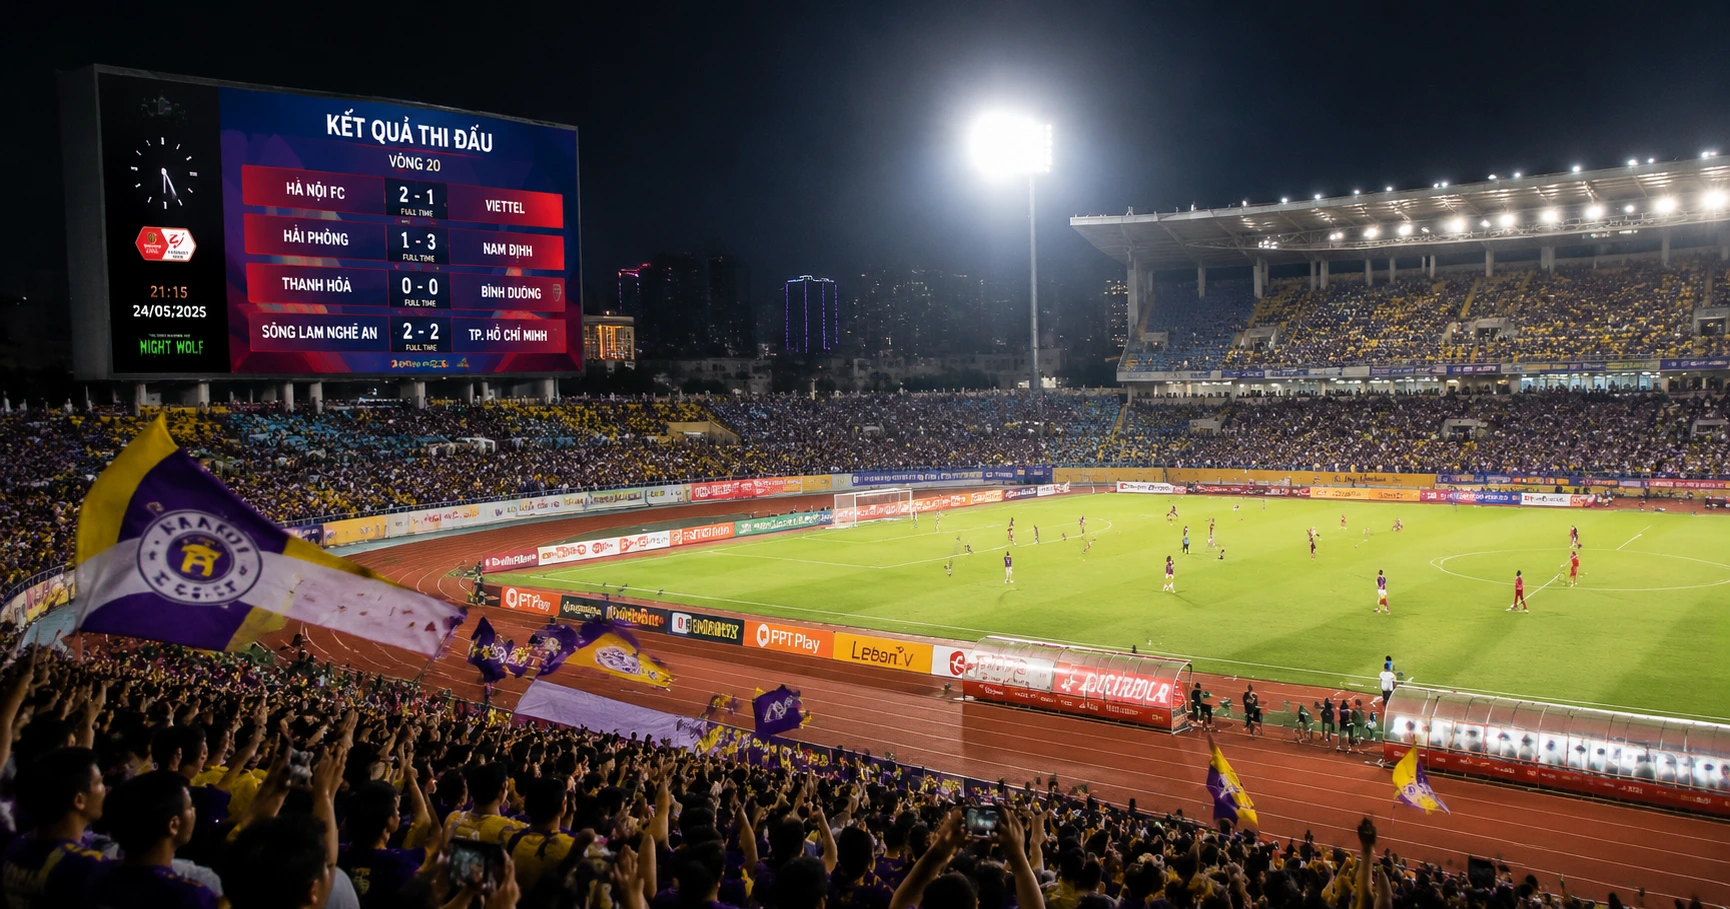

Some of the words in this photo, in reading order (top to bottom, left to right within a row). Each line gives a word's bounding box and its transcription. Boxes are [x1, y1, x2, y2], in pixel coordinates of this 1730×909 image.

[326, 108, 366, 138] KẾT
[371, 116, 414, 145] QUẢ
[418, 124, 449, 148] THI
[453, 124, 493, 153] ĐẤU
[426, 158, 441, 172] 20
[330, 186, 346, 200] FC
[399, 185, 409, 203] 2
[426, 189, 434, 205] 1
[400, 208, 416, 217] FULL
[485, 199, 526, 214] VIETTEL
[283, 224, 305, 244] HẢI
[307, 228, 349, 246] PHÒNG
[401, 231, 410, 249] 1
[426, 233, 437, 250] 3
[483, 242, 506, 256] NAM
[402, 253, 418, 262] FULL
[281, 276, 324, 292] THANH
[401, 276, 412, 295] 0
[428, 278, 439, 296] 0
[150, 285, 188, 299] 21:15
[404, 298, 420, 307] FULL
[299, 325, 324, 339] LAM
[361, 326, 378, 340] AN
[402, 322, 413, 340] 2
[430, 322, 440, 340] 2
[468, 329, 485, 342] TP.
[140, 339, 172, 356] NIGHT
[176, 339, 204, 356] WOLF
[771, 629, 794, 647] PPT
[794, 633, 821, 655] Play
